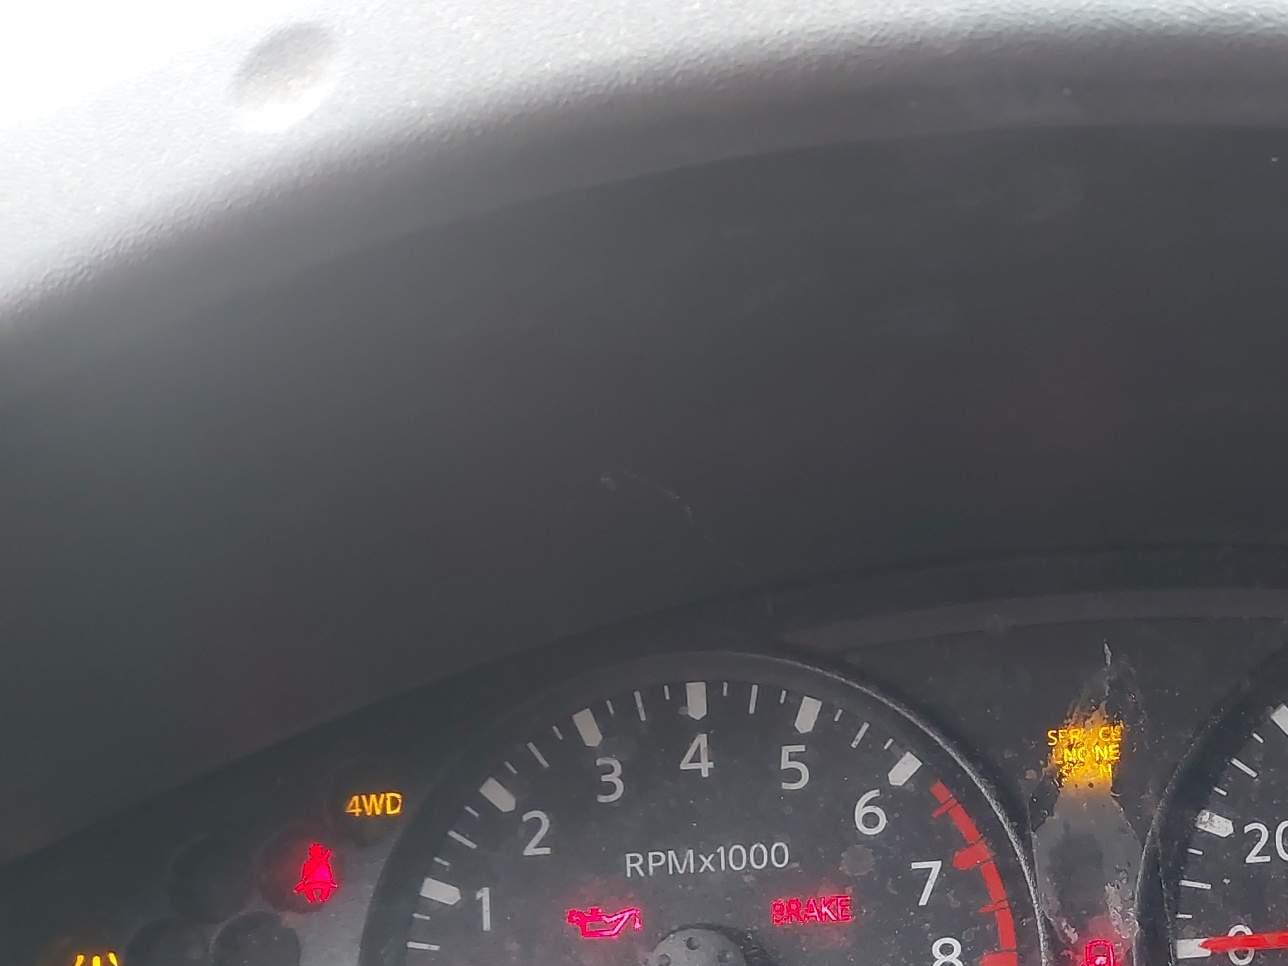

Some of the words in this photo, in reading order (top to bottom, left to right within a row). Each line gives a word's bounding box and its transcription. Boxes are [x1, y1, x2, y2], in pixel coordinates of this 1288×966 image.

[679, 733, 714, 777] 4
[779, 745, 810, 790] 5
[595, 757, 625, 803] 3
[345, 792, 403, 817] 4WD
[854, 789, 887, 835] 6
[522, 810, 551, 856] 2
[625, 841, 790, 878] RPMx1000
[910, 860, 943, 906] 7
[475, 886, 492, 932] 1
[771, 895, 851, 926] BRAKE
